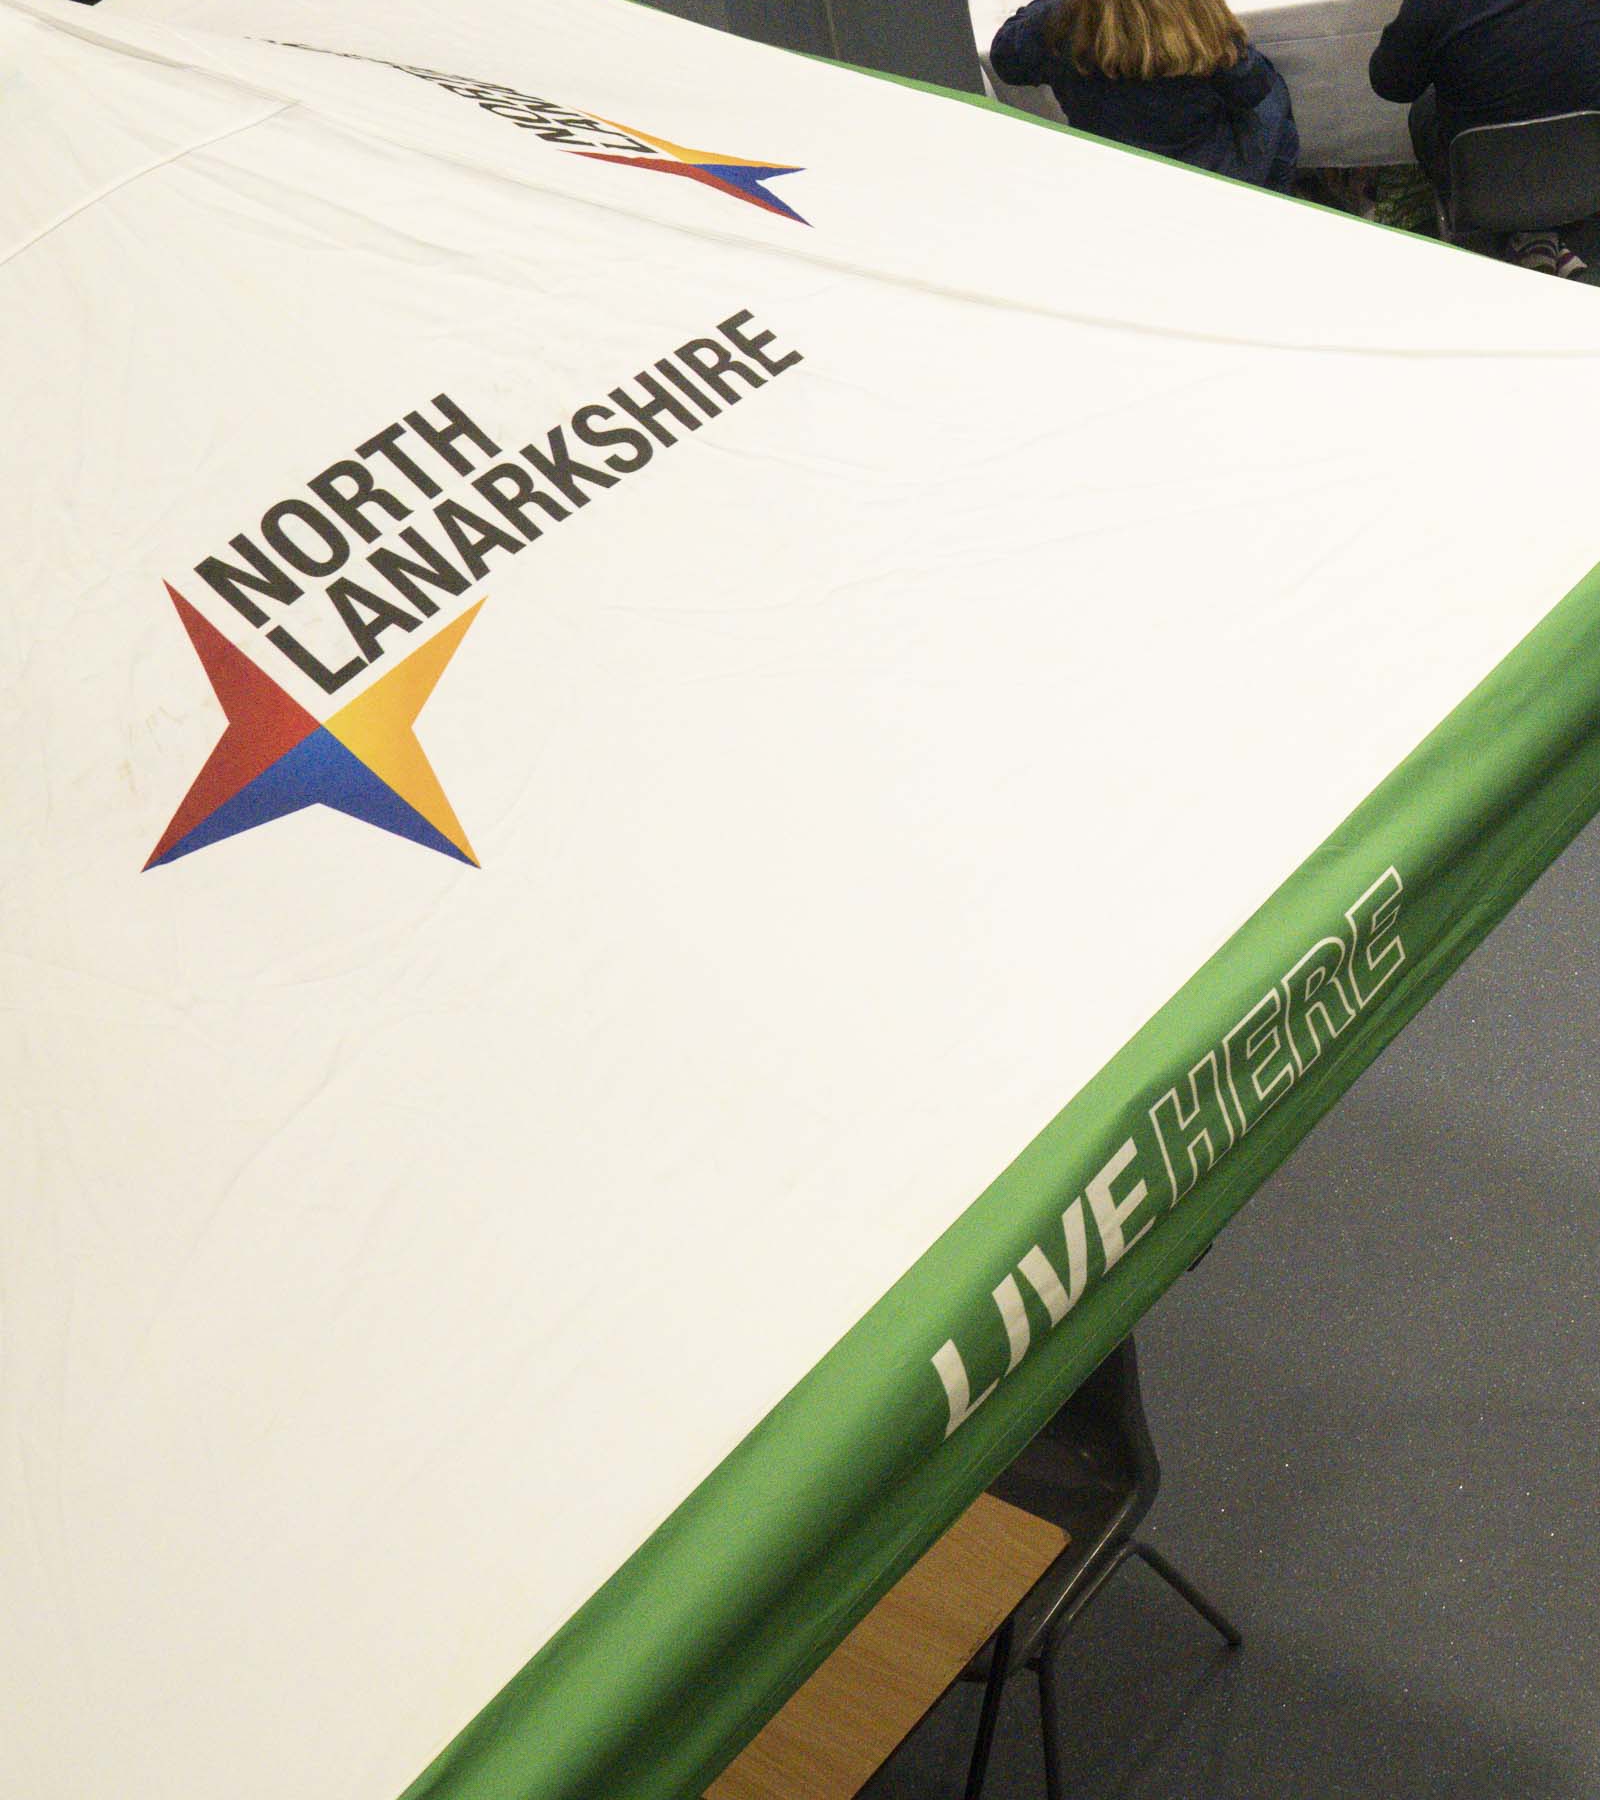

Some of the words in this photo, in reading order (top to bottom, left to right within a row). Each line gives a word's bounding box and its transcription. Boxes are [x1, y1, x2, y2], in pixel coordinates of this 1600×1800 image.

[192, 391, 503, 629] NORTH
[265, 307, 805, 696] LANARKSHIRE
[930, 1135, 1157, 1442] LIVE
[1148, 864, 1406, 1209] HERE
